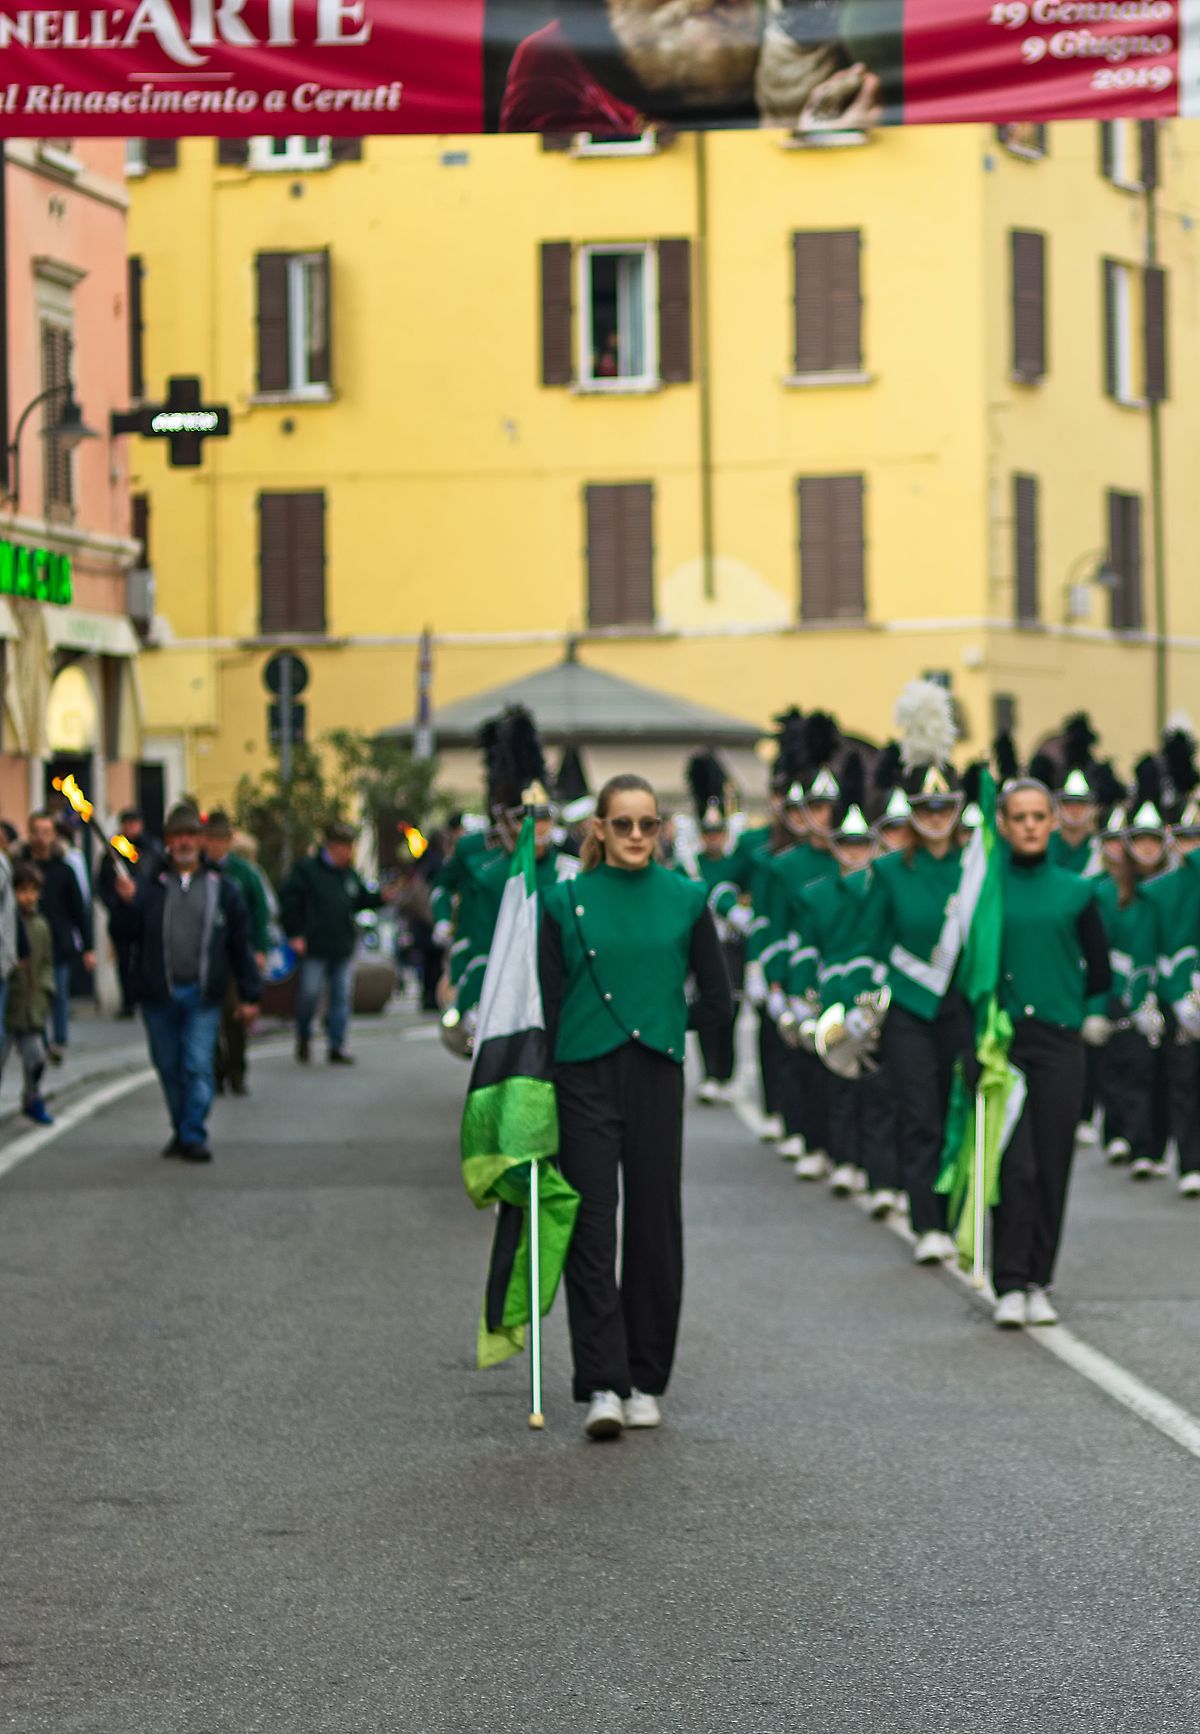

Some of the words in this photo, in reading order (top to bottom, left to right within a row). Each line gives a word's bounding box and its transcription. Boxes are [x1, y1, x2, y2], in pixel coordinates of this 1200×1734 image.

[988, 2, 1027, 28] 19
[1031, 0, 1172, 24] Gennaio
[1020, 35, 1047, 64] 9
[1049, 29, 1172, 61] Giugno
[1090, 66, 1173, 91] 2019
[23, 83, 257, 114] Rinascimento
[263, 88, 286, 112] a
[293, 81, 402, 111] Ceruti
